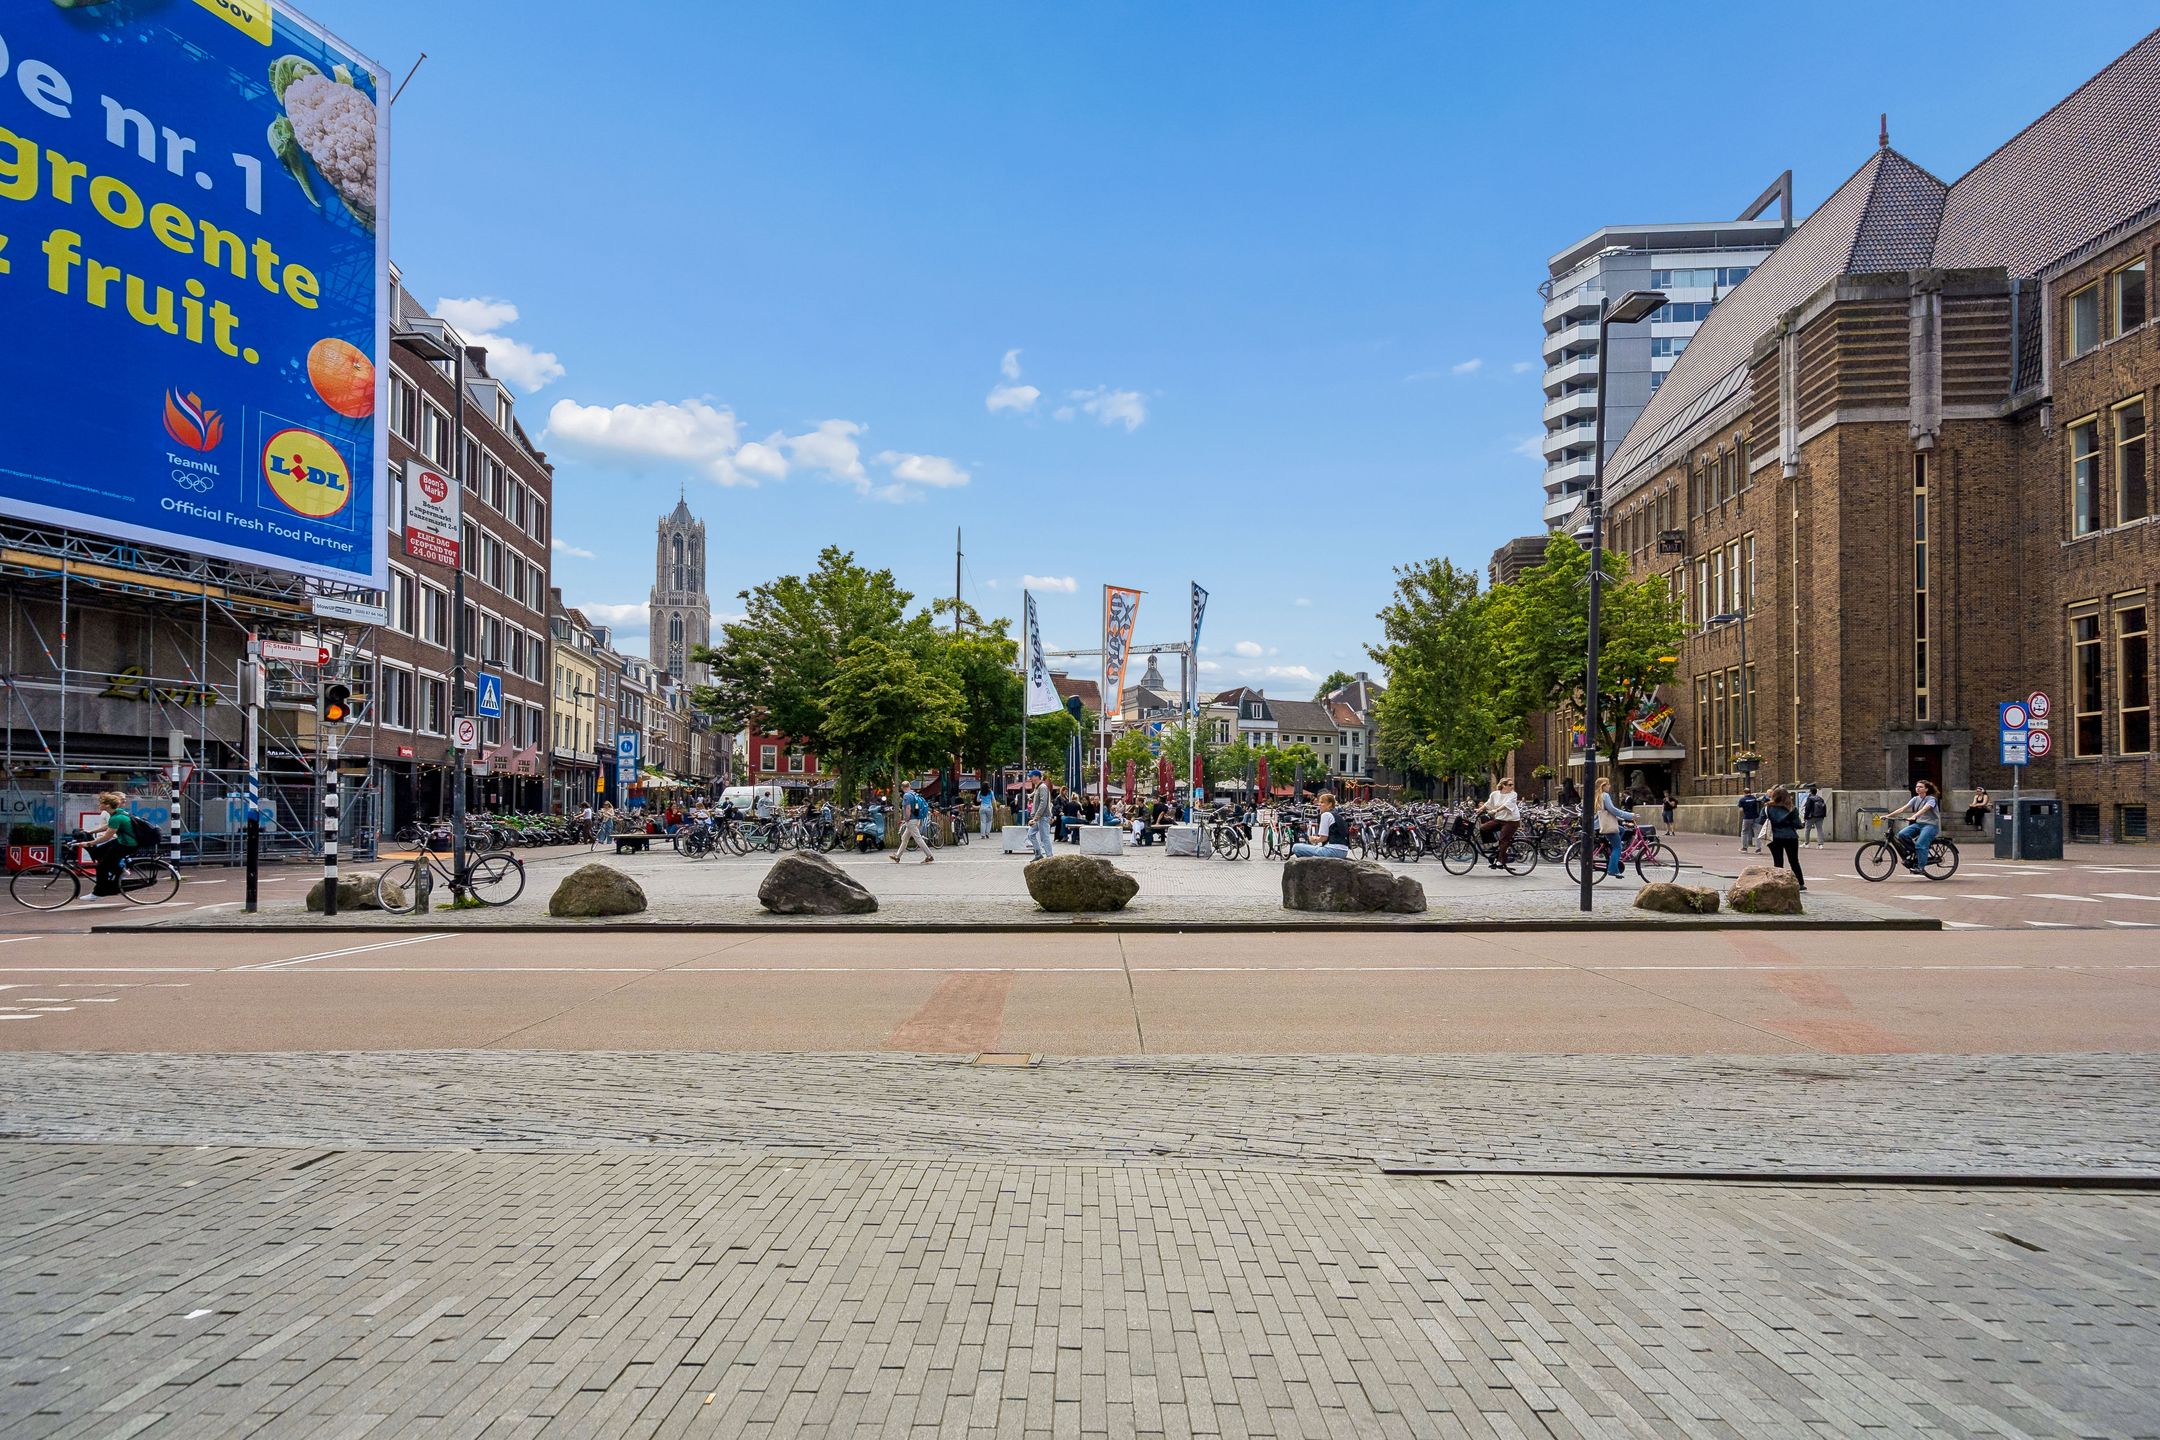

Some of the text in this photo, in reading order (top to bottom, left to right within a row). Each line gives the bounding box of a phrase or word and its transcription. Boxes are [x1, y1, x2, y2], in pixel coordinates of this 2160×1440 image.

[0, 34, 261, 215] e nr. 1
[0, 126, 319, 309] groente
[42, 229, 259, 364] fruit.
[166, 452, 220, 476] TeamNL
[423, 474, 444, 490] Boon's
[424, 483, 444, 498] Markt
[414, 506, 452, 523] supermarkt
[422, 500, 444, 513] Boon's
[161, 497, 354, 554] Official Fresh Food Partner
[409, 510, 447, 528] Ganzemarkt
[410, 537, 457, 558] GEOPEND TOT
[417, 531, 450, 548] ELKE DAG
[413, 546, 455, 566] 24.00 UUR
[273, 643, 302, 652] Stadhuis
